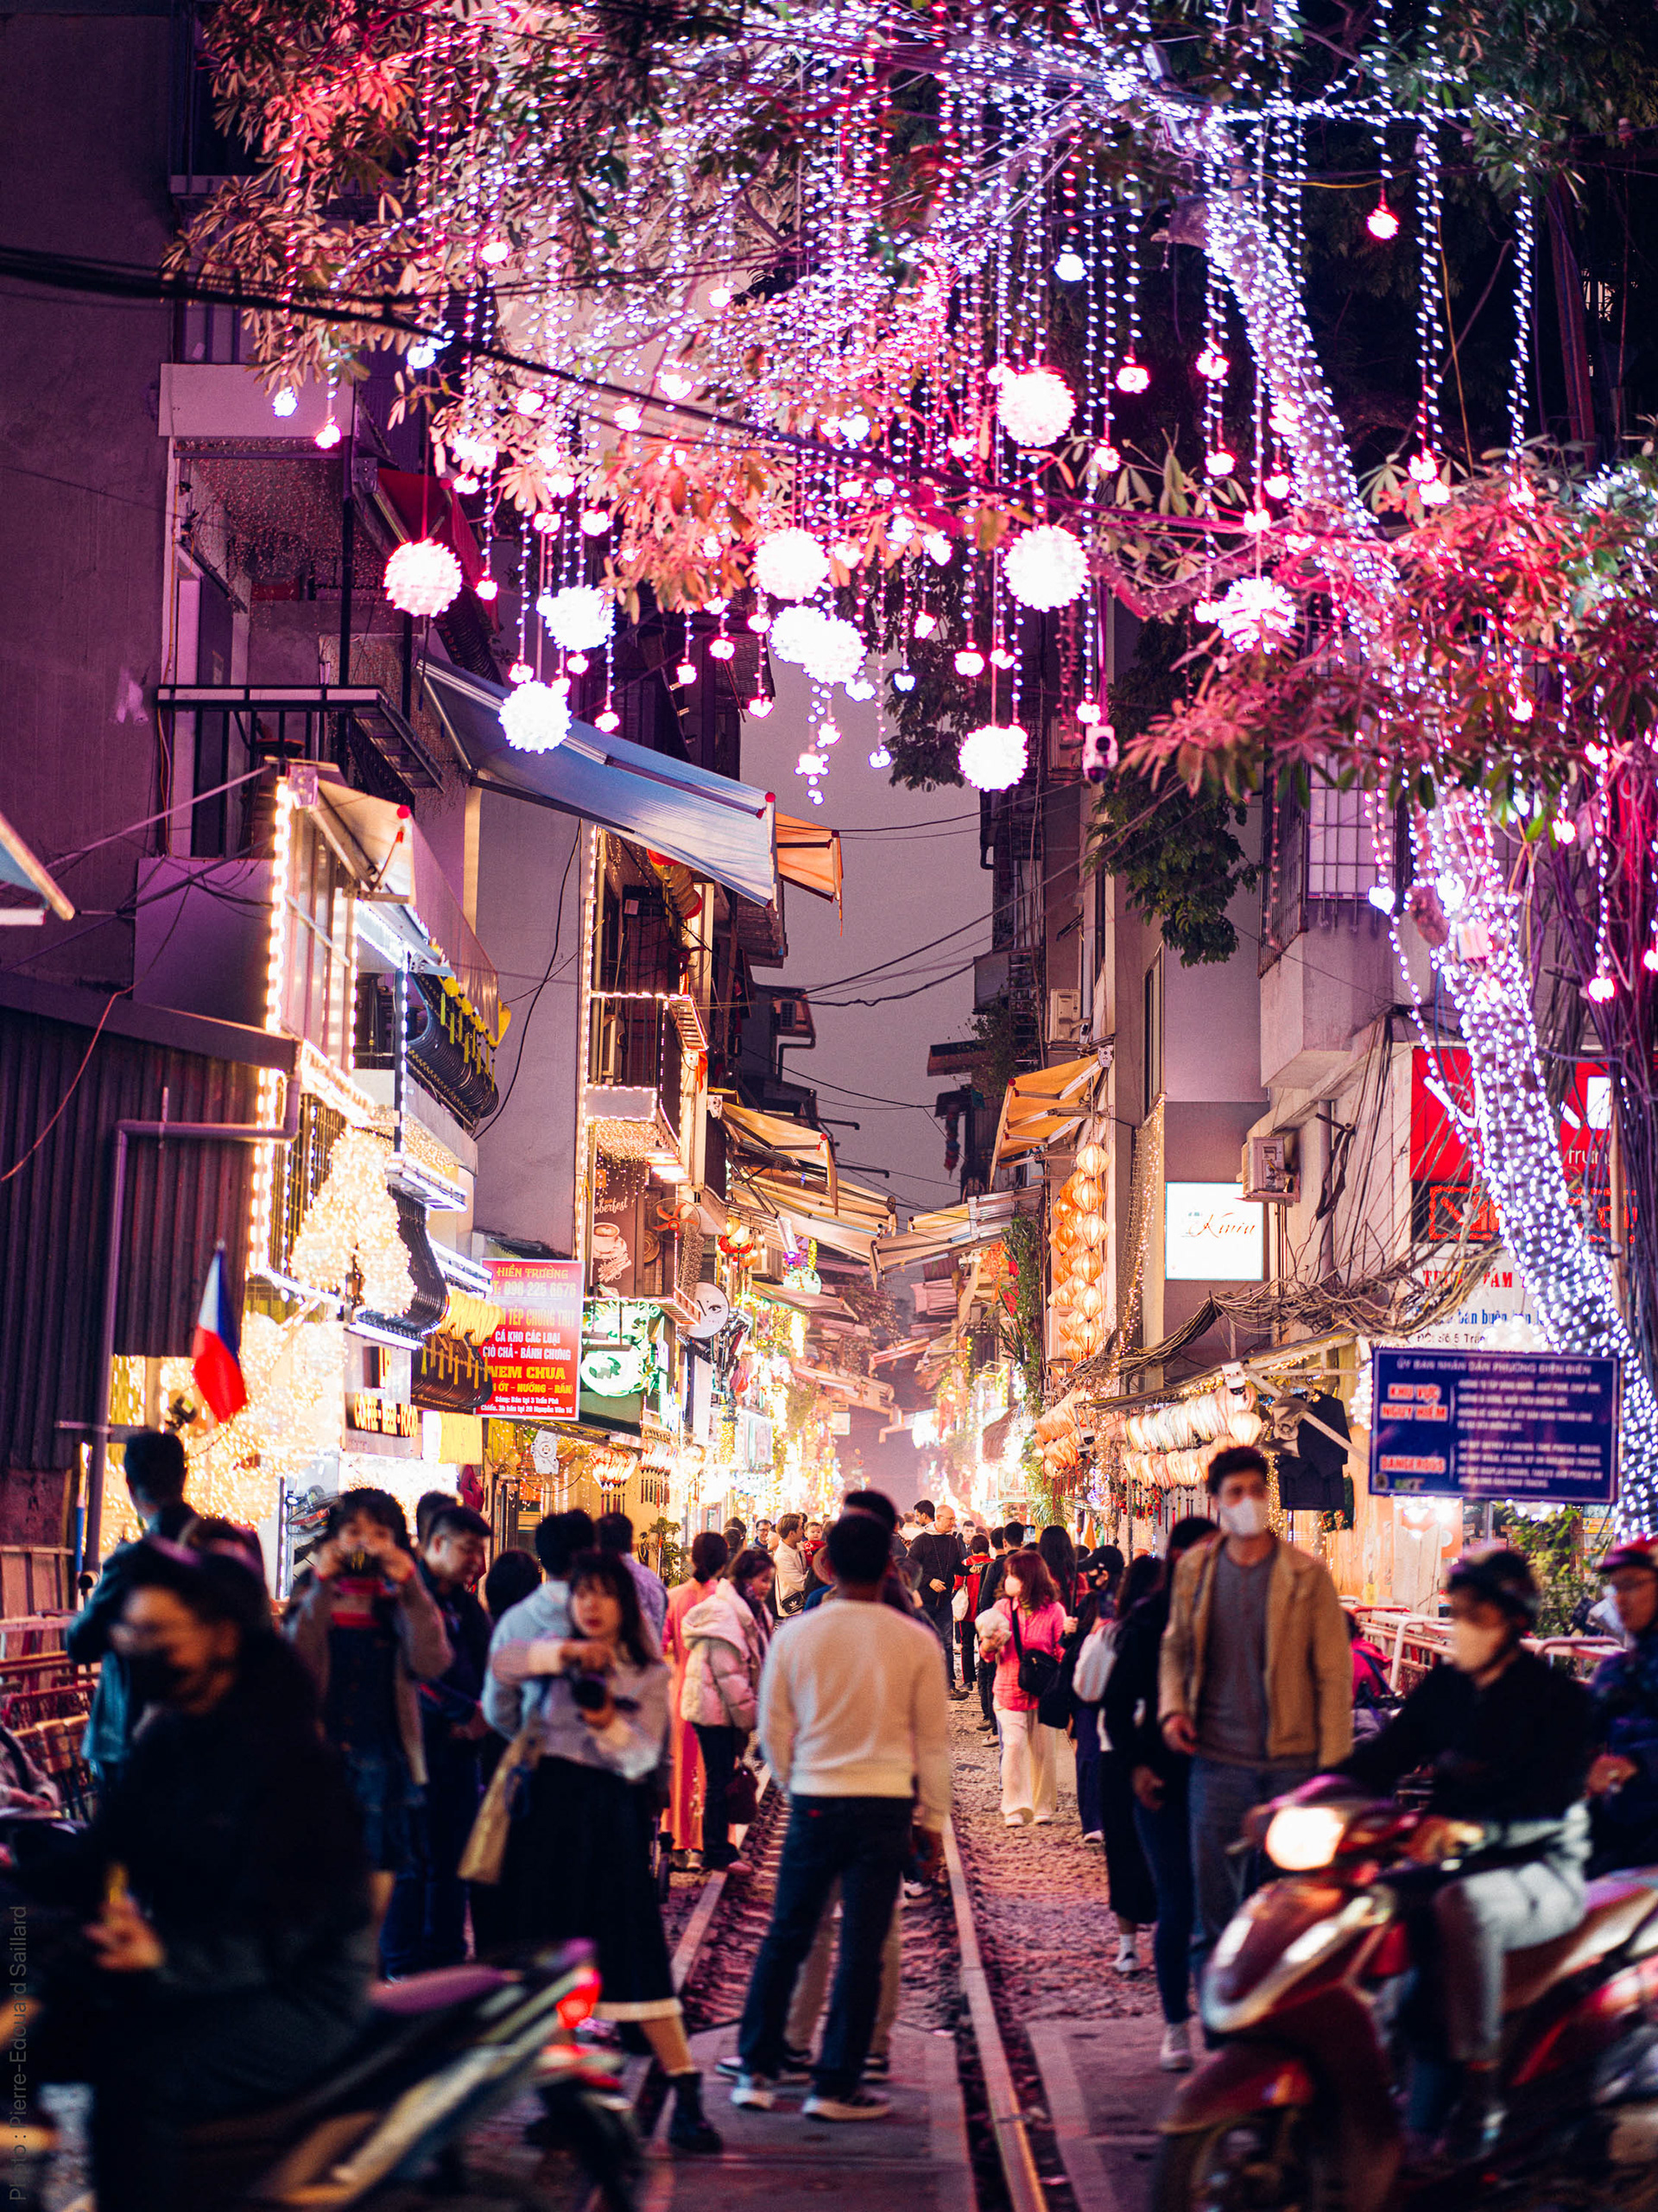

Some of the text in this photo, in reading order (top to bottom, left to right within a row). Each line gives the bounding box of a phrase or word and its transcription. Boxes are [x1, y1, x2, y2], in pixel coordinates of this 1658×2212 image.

[525, 1264, 569, 1279] TRƯỜNG
[509, 1306, 524, 1326] TÉP
[495, 1328, 561, 1346] CÁ KHO CÁC LOẠI
[497, 1343, 514, 1359] CHẢ
[520, 1345, 542, 1360] BÁNH
[526, 1366, 566, 1379] CHUA
[1380, 1455, 1446, 1474] DANGEROUS
